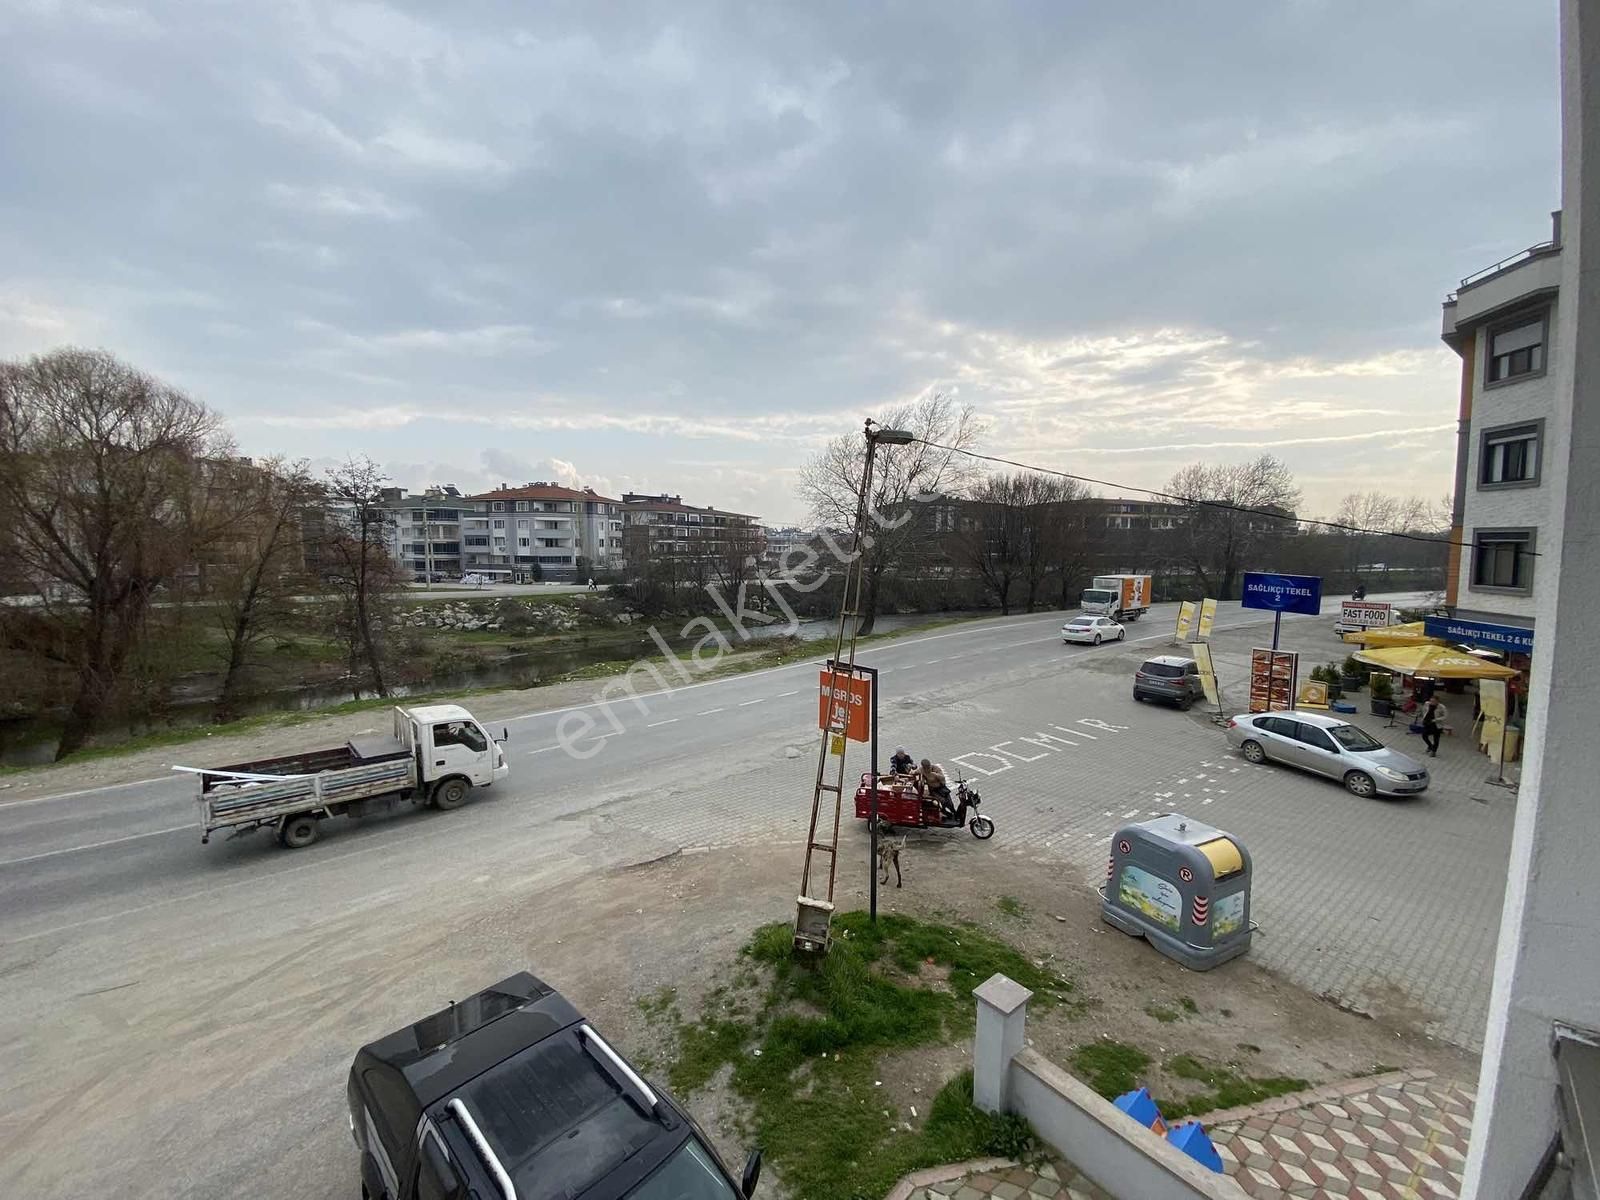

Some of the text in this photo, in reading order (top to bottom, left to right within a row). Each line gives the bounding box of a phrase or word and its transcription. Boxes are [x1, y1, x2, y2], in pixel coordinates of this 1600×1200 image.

[1247, 583, 1312, 596] SAĞLIKÇI TEKEL
[1274, 594, 1281, 602] 2
[1343, 608, 1386, 621] FAST FOOD
[1447, 626, 1480, 639] SAĞLIKÇI
[1481, 631, 1506, 642] TEKEL
[1507, 635, 1513, 643] 2
[821, 685, 863, 706] MGROS
